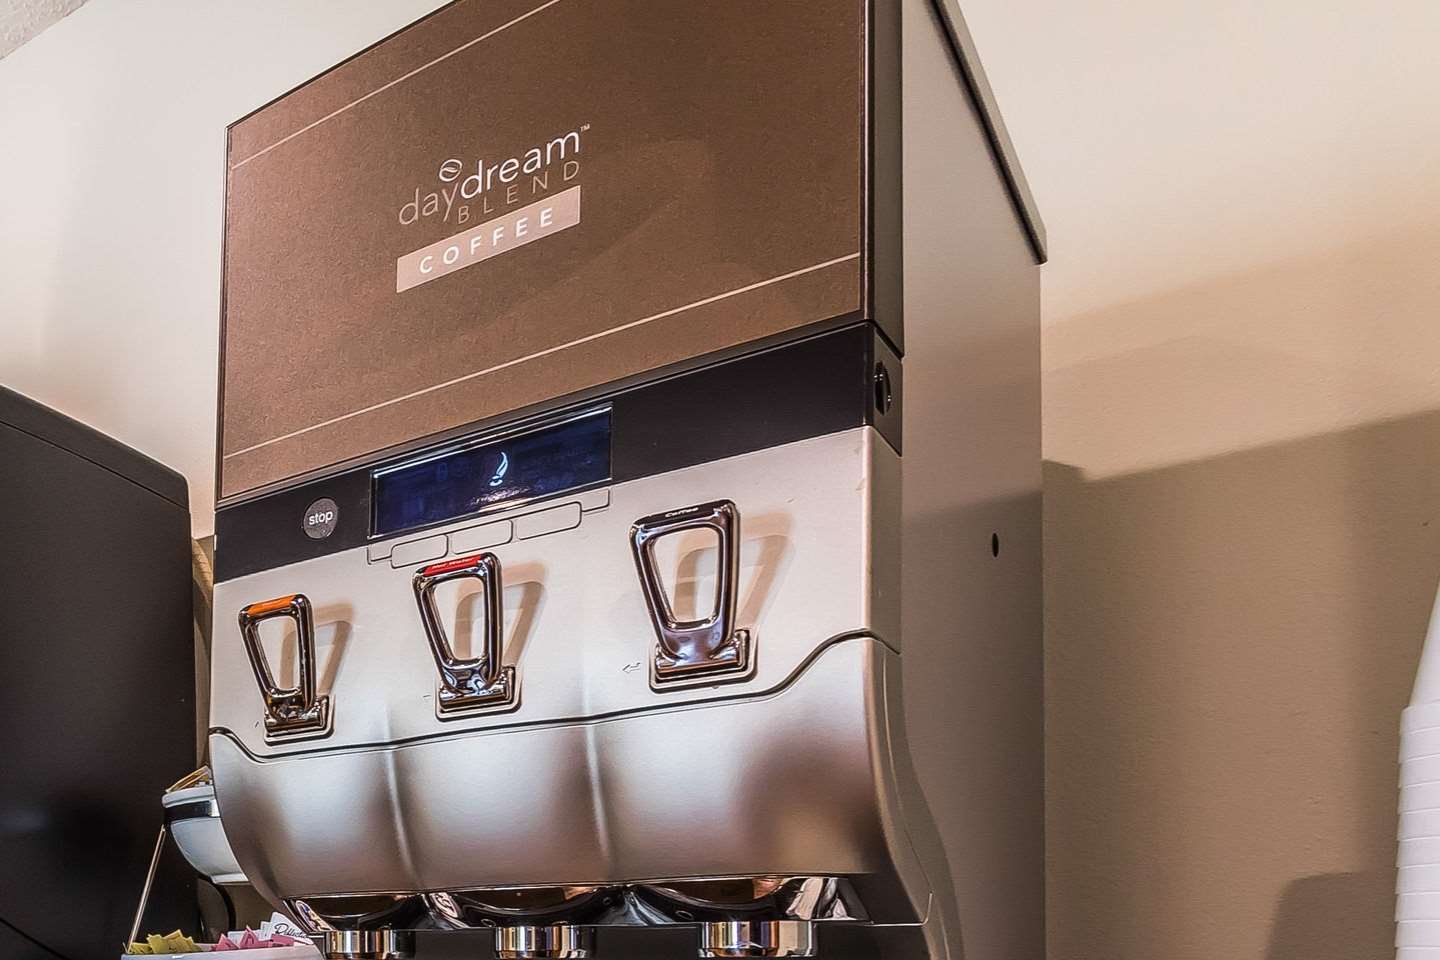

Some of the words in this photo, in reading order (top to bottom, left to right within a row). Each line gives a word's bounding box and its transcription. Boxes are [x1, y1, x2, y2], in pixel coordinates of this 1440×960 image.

[458, 160, 580, 224] BLEND
[419, 208, 553, 274] COFFEE
[308, 511, 334, 525] stop
